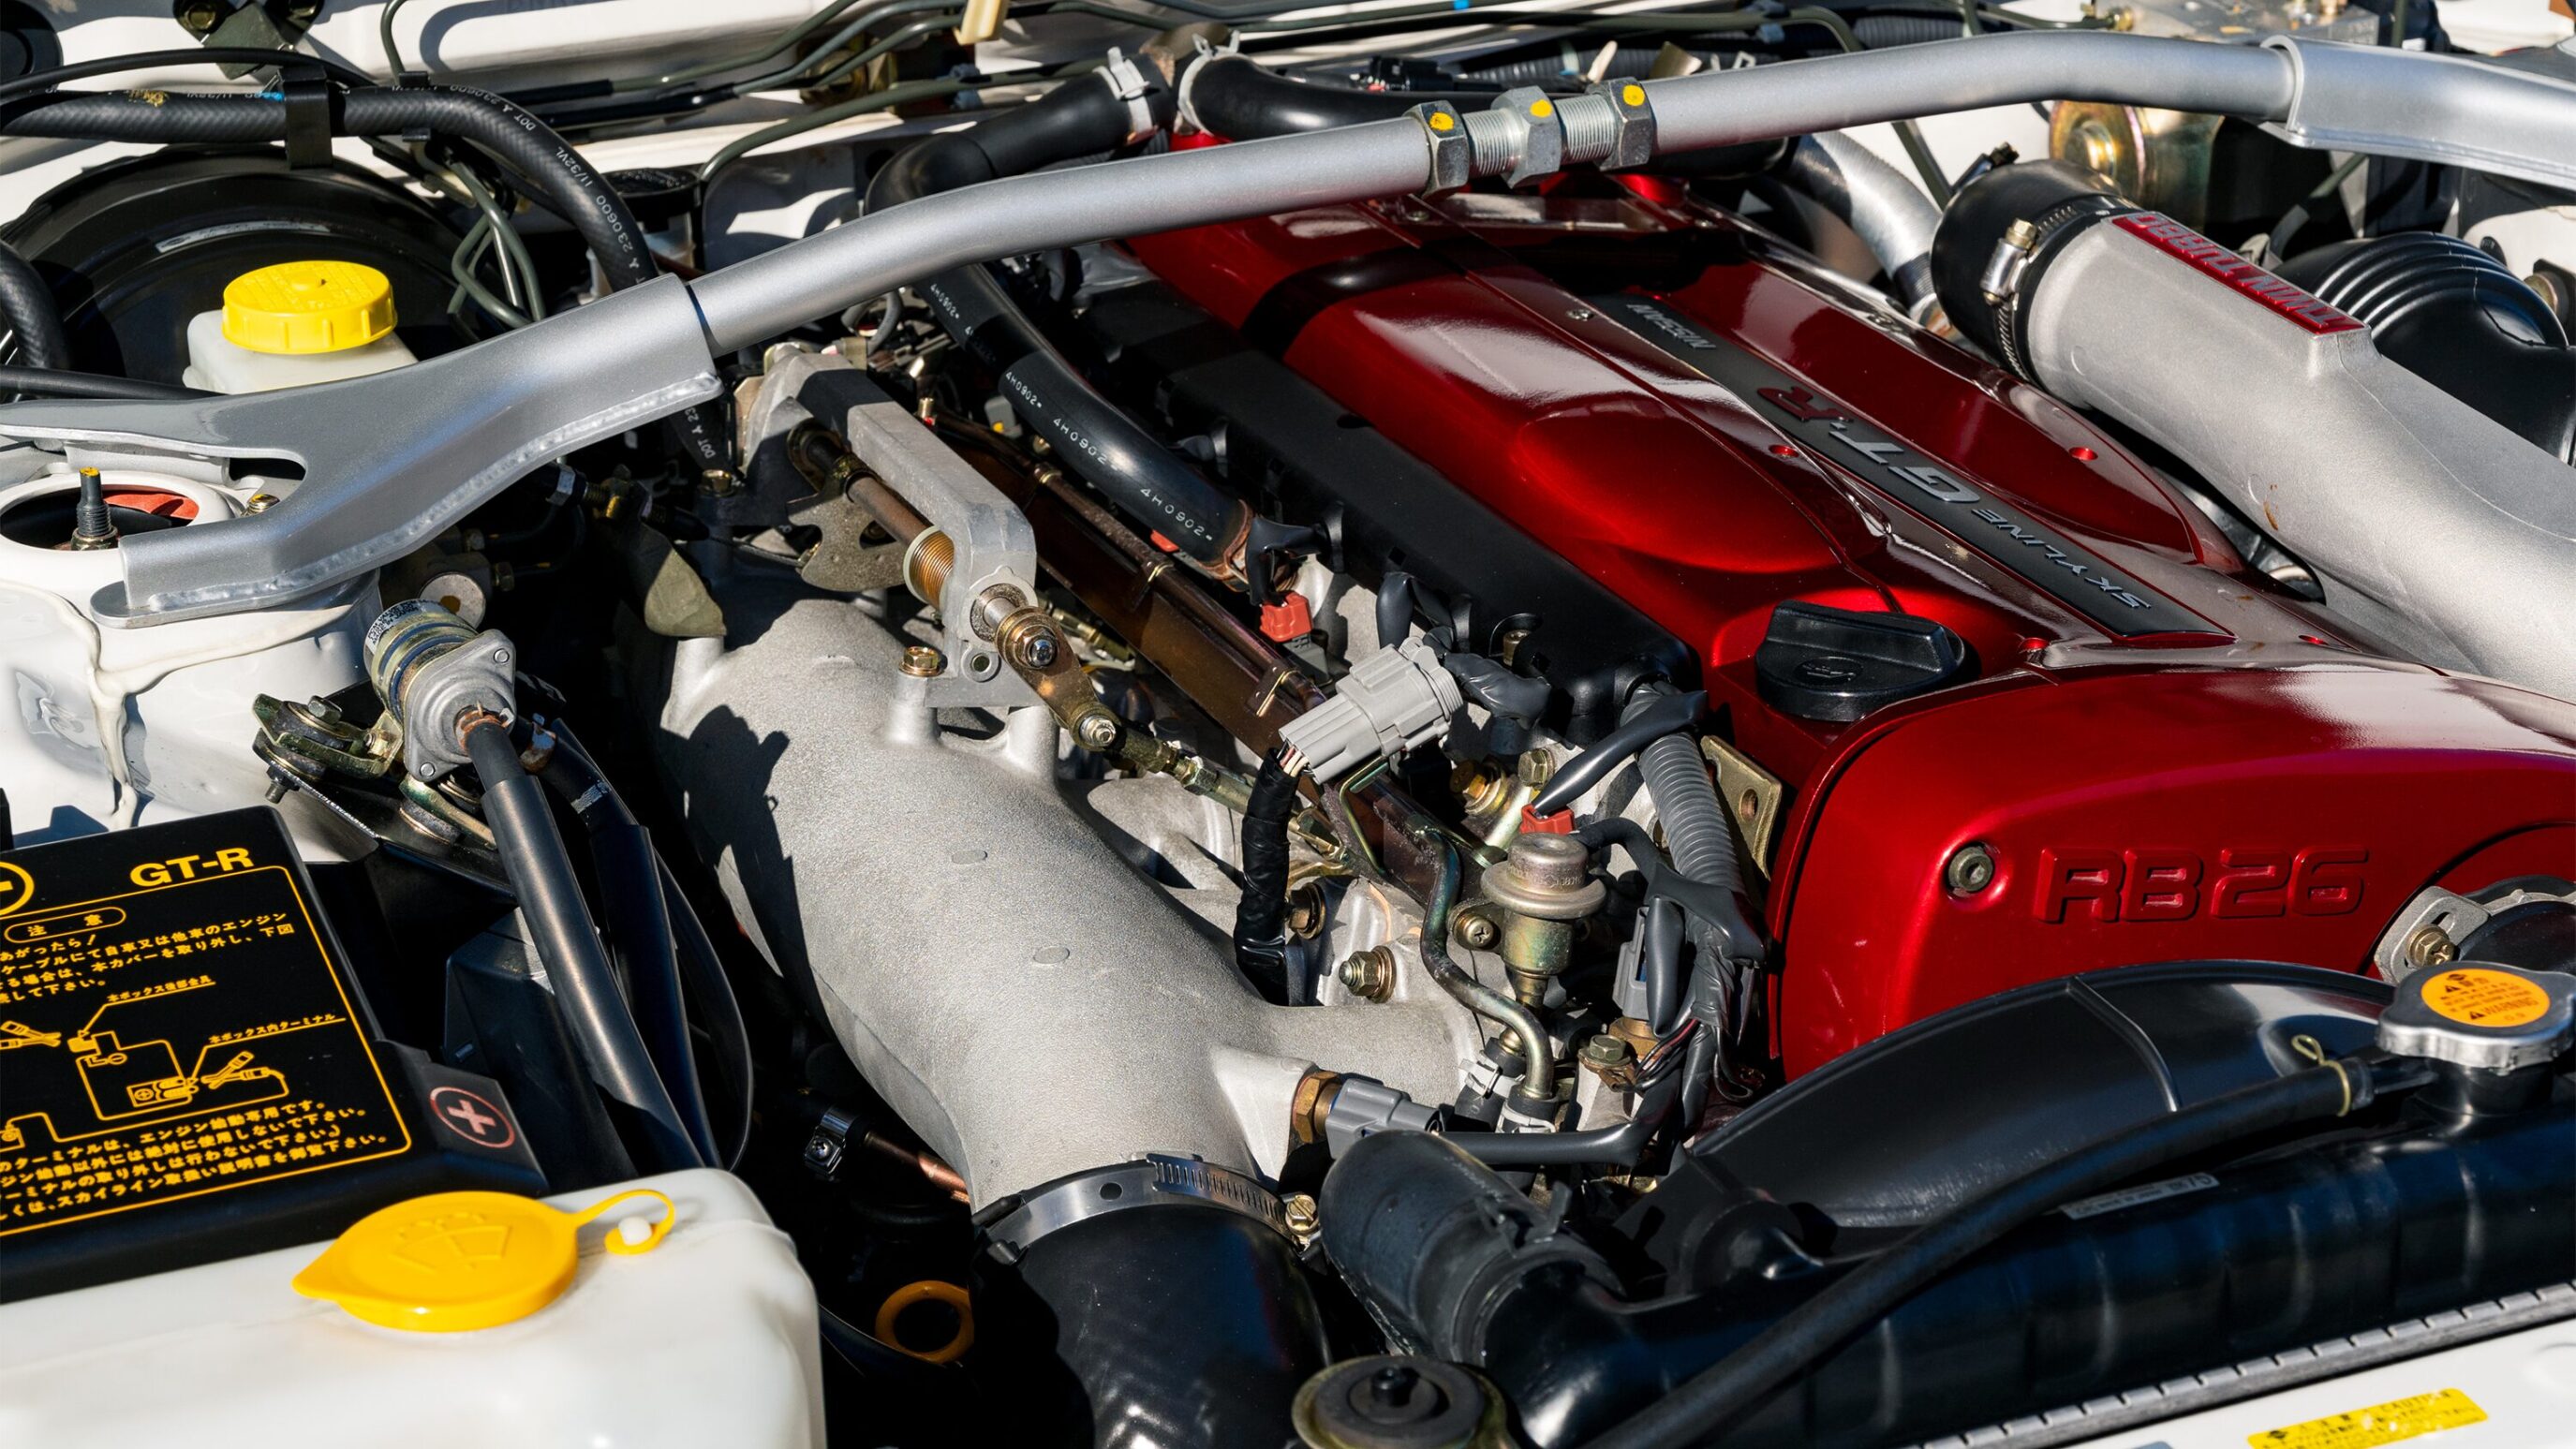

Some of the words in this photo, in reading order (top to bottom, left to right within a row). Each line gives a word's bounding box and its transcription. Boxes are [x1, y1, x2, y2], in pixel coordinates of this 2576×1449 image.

[514, 114, 537, 131] DOT
[596, 194, 633, 253] 230600
[2126, 214, 2252, 277] TURBO
[2240, 274, 2346, 329] TWIN
[1625, 303, 1716, 351] NISSAN
[1006, 371, 1038, 406] 4H0902
[697, 438, 716, 459] DOT
[1053, 417, 1108, 465] 4H0902
[1140, 487, 1206, 535] 4H0902
[1972, 508, 2152, 611] SKYLINE
[130, 848, 254, 887] GT-R
[2033, 845, 2370, 924] RB26
[0, 924, 295, 989] る場合は、本カバーを取り外し、下図
